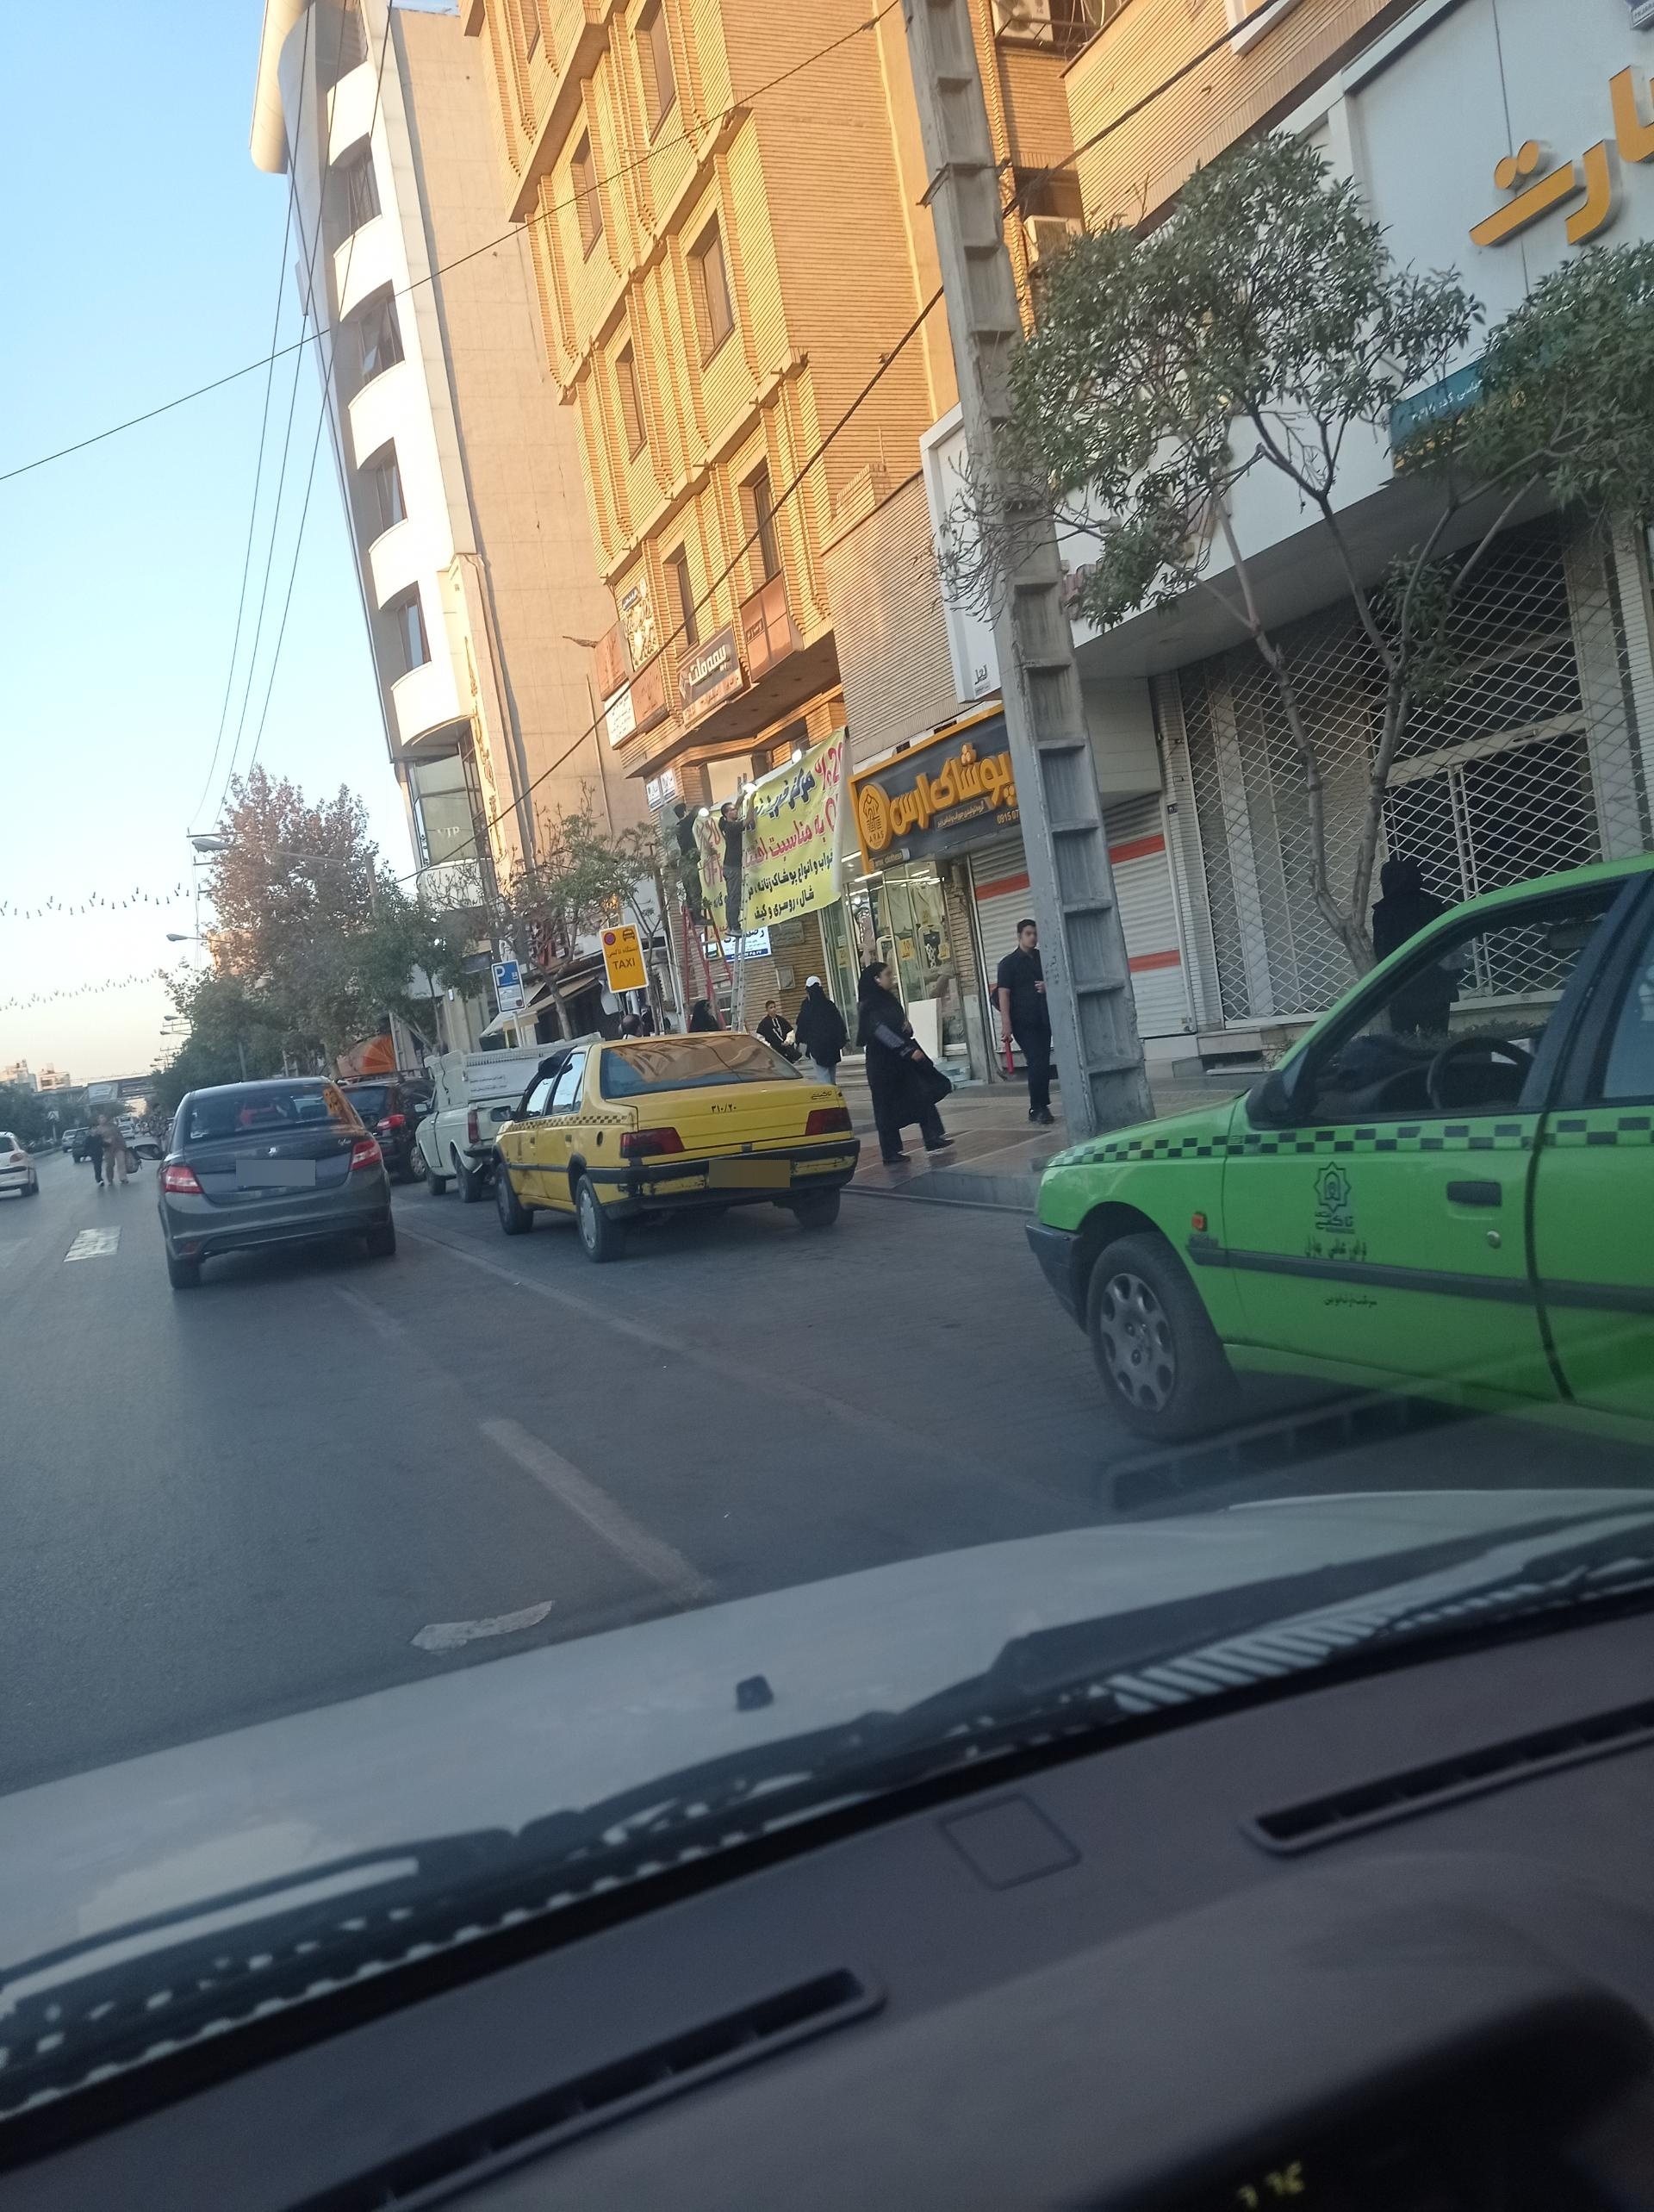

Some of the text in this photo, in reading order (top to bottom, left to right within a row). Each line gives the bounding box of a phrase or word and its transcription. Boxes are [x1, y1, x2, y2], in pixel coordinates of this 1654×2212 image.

[930, 743, 1018, 811] پوشاک
[890, 773, 935, 836] ارس
[437, 826, 460, 838] VIP
[770, 820, 813, 863] مناسبت
[814, 814, 824, 844] به
[869, 830, 885, 844] ARAS
[494, 966, 506, 987] P
[612, 958, 636, 971] TAXI
